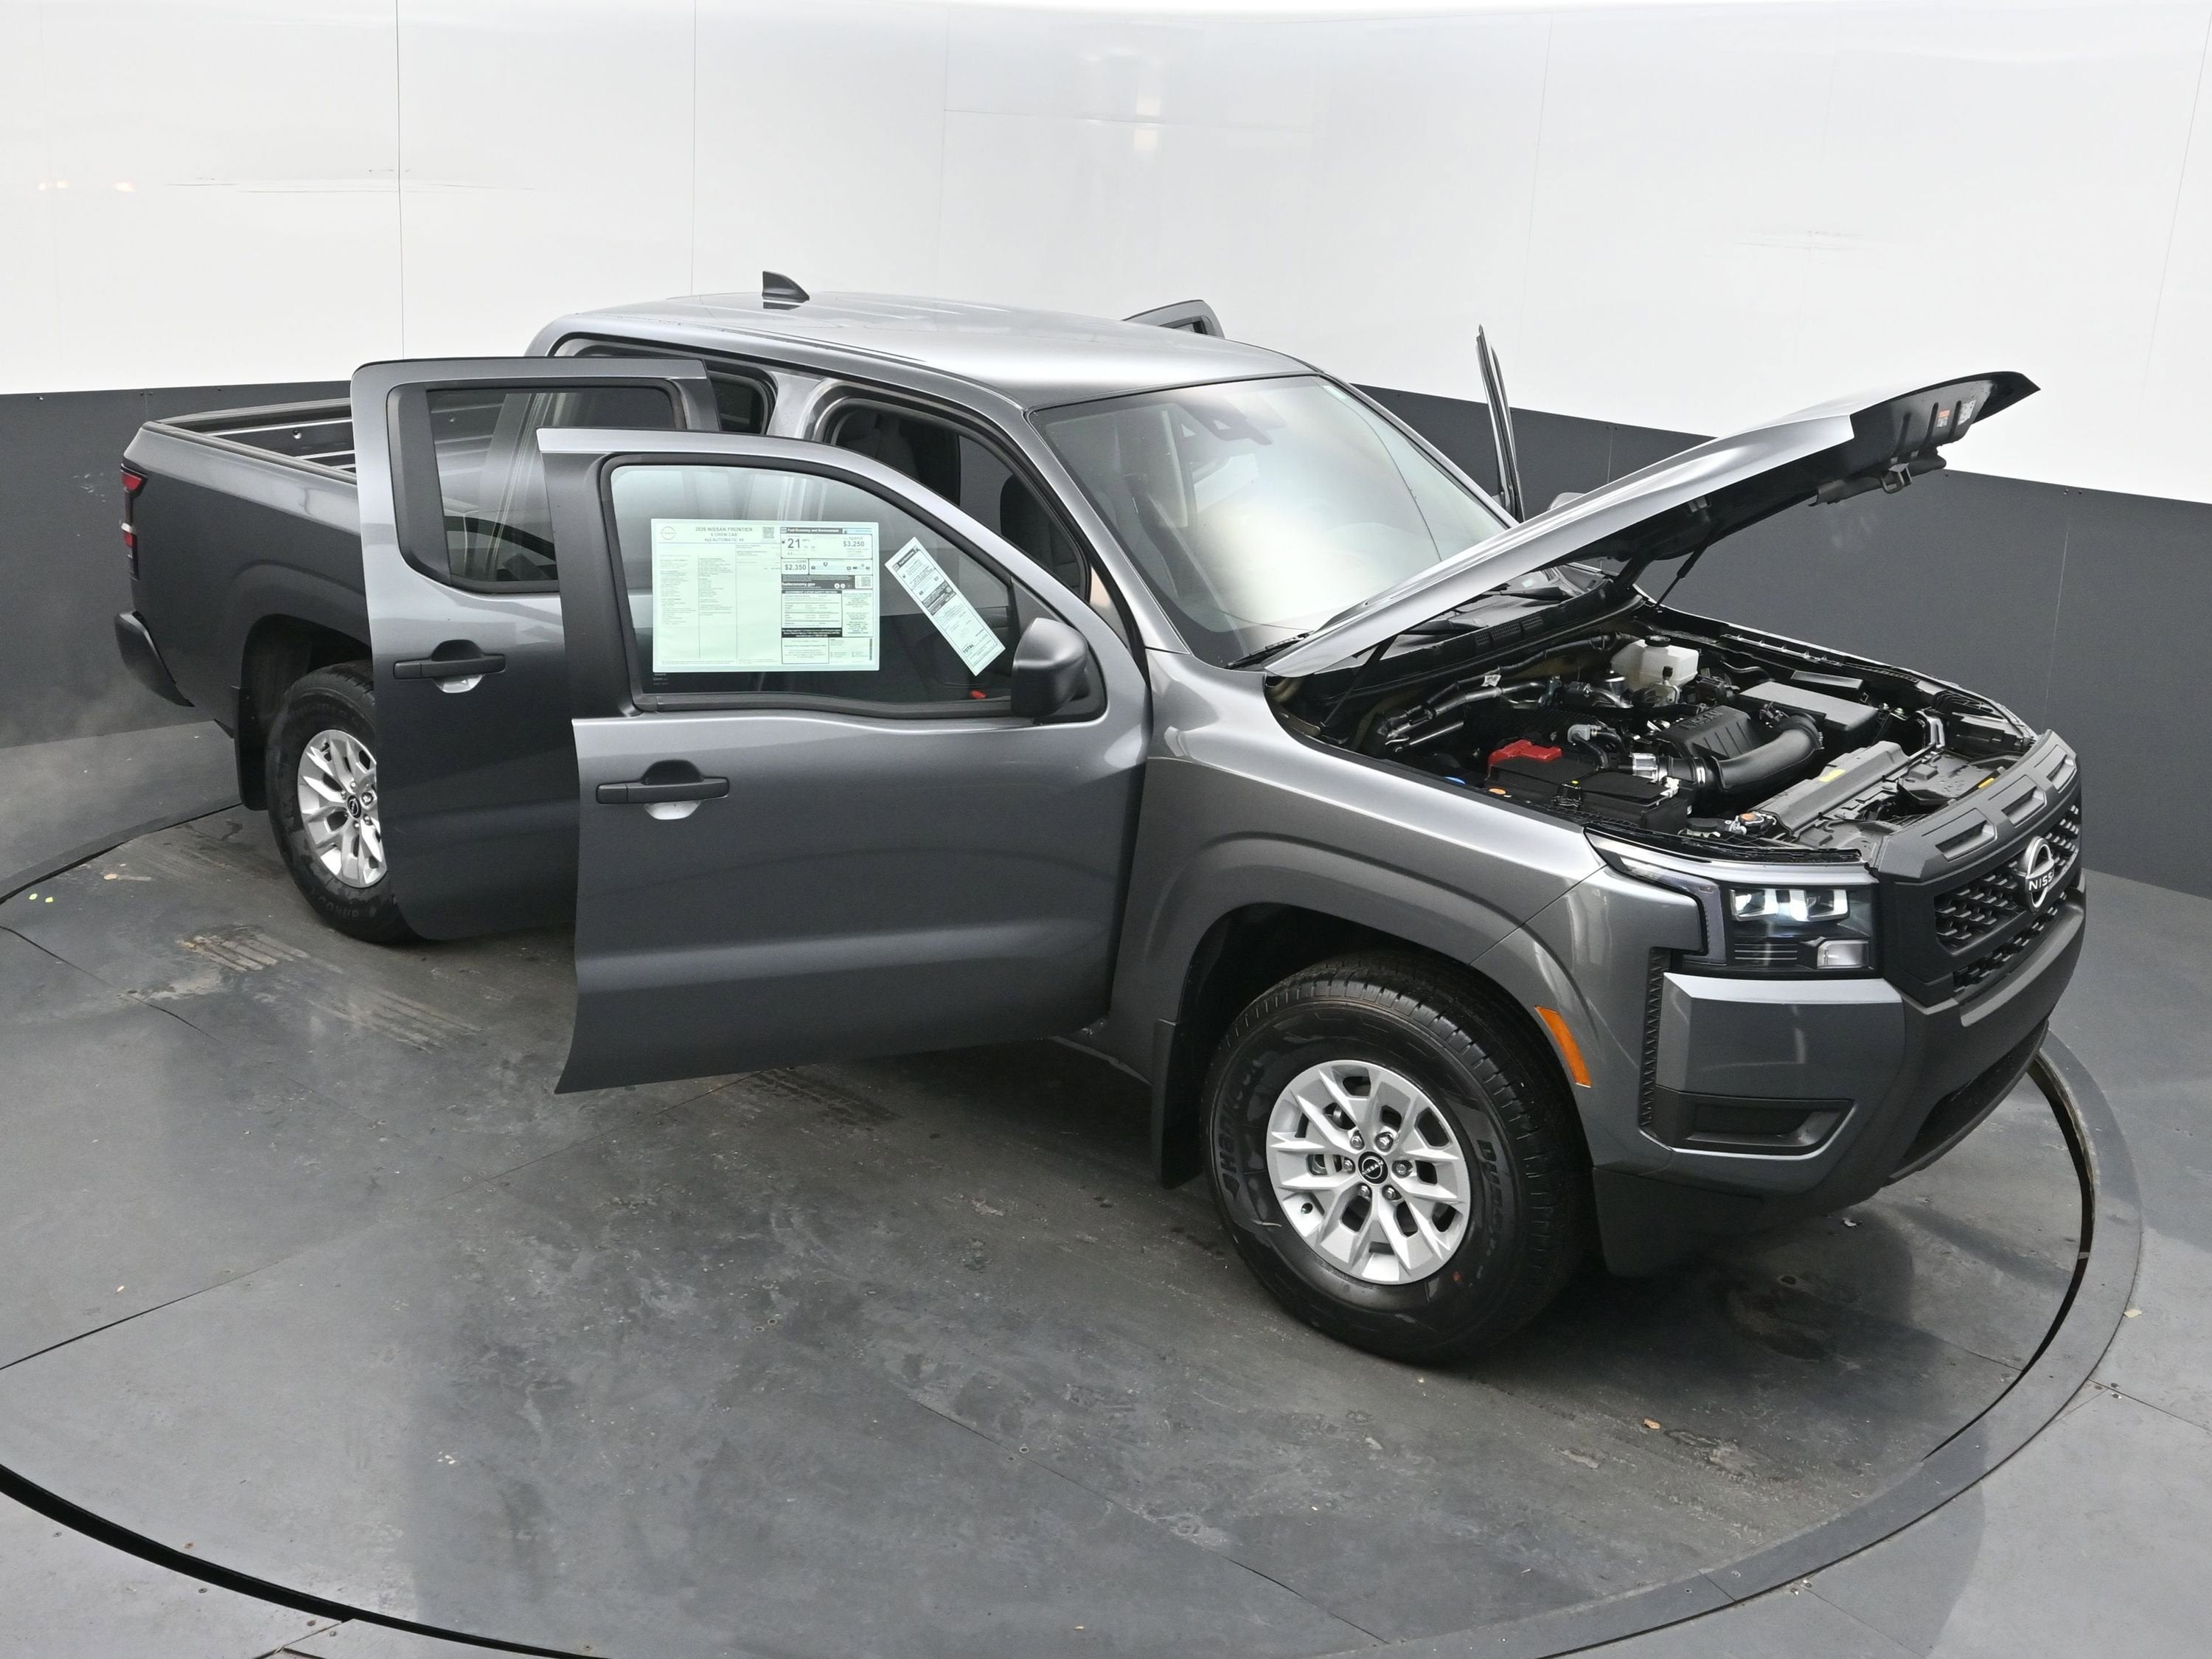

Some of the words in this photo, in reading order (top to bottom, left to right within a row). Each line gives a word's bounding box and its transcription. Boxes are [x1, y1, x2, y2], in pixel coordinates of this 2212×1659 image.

[787, 538, 800, 549] 21
[962, 643, 974, 654] TOTAL
[1680, 710, 1723, 731] NISSAN
[2028, 870, 2054, 891] NISS
[1362, 1160, 1384, 1176] NISSAN
